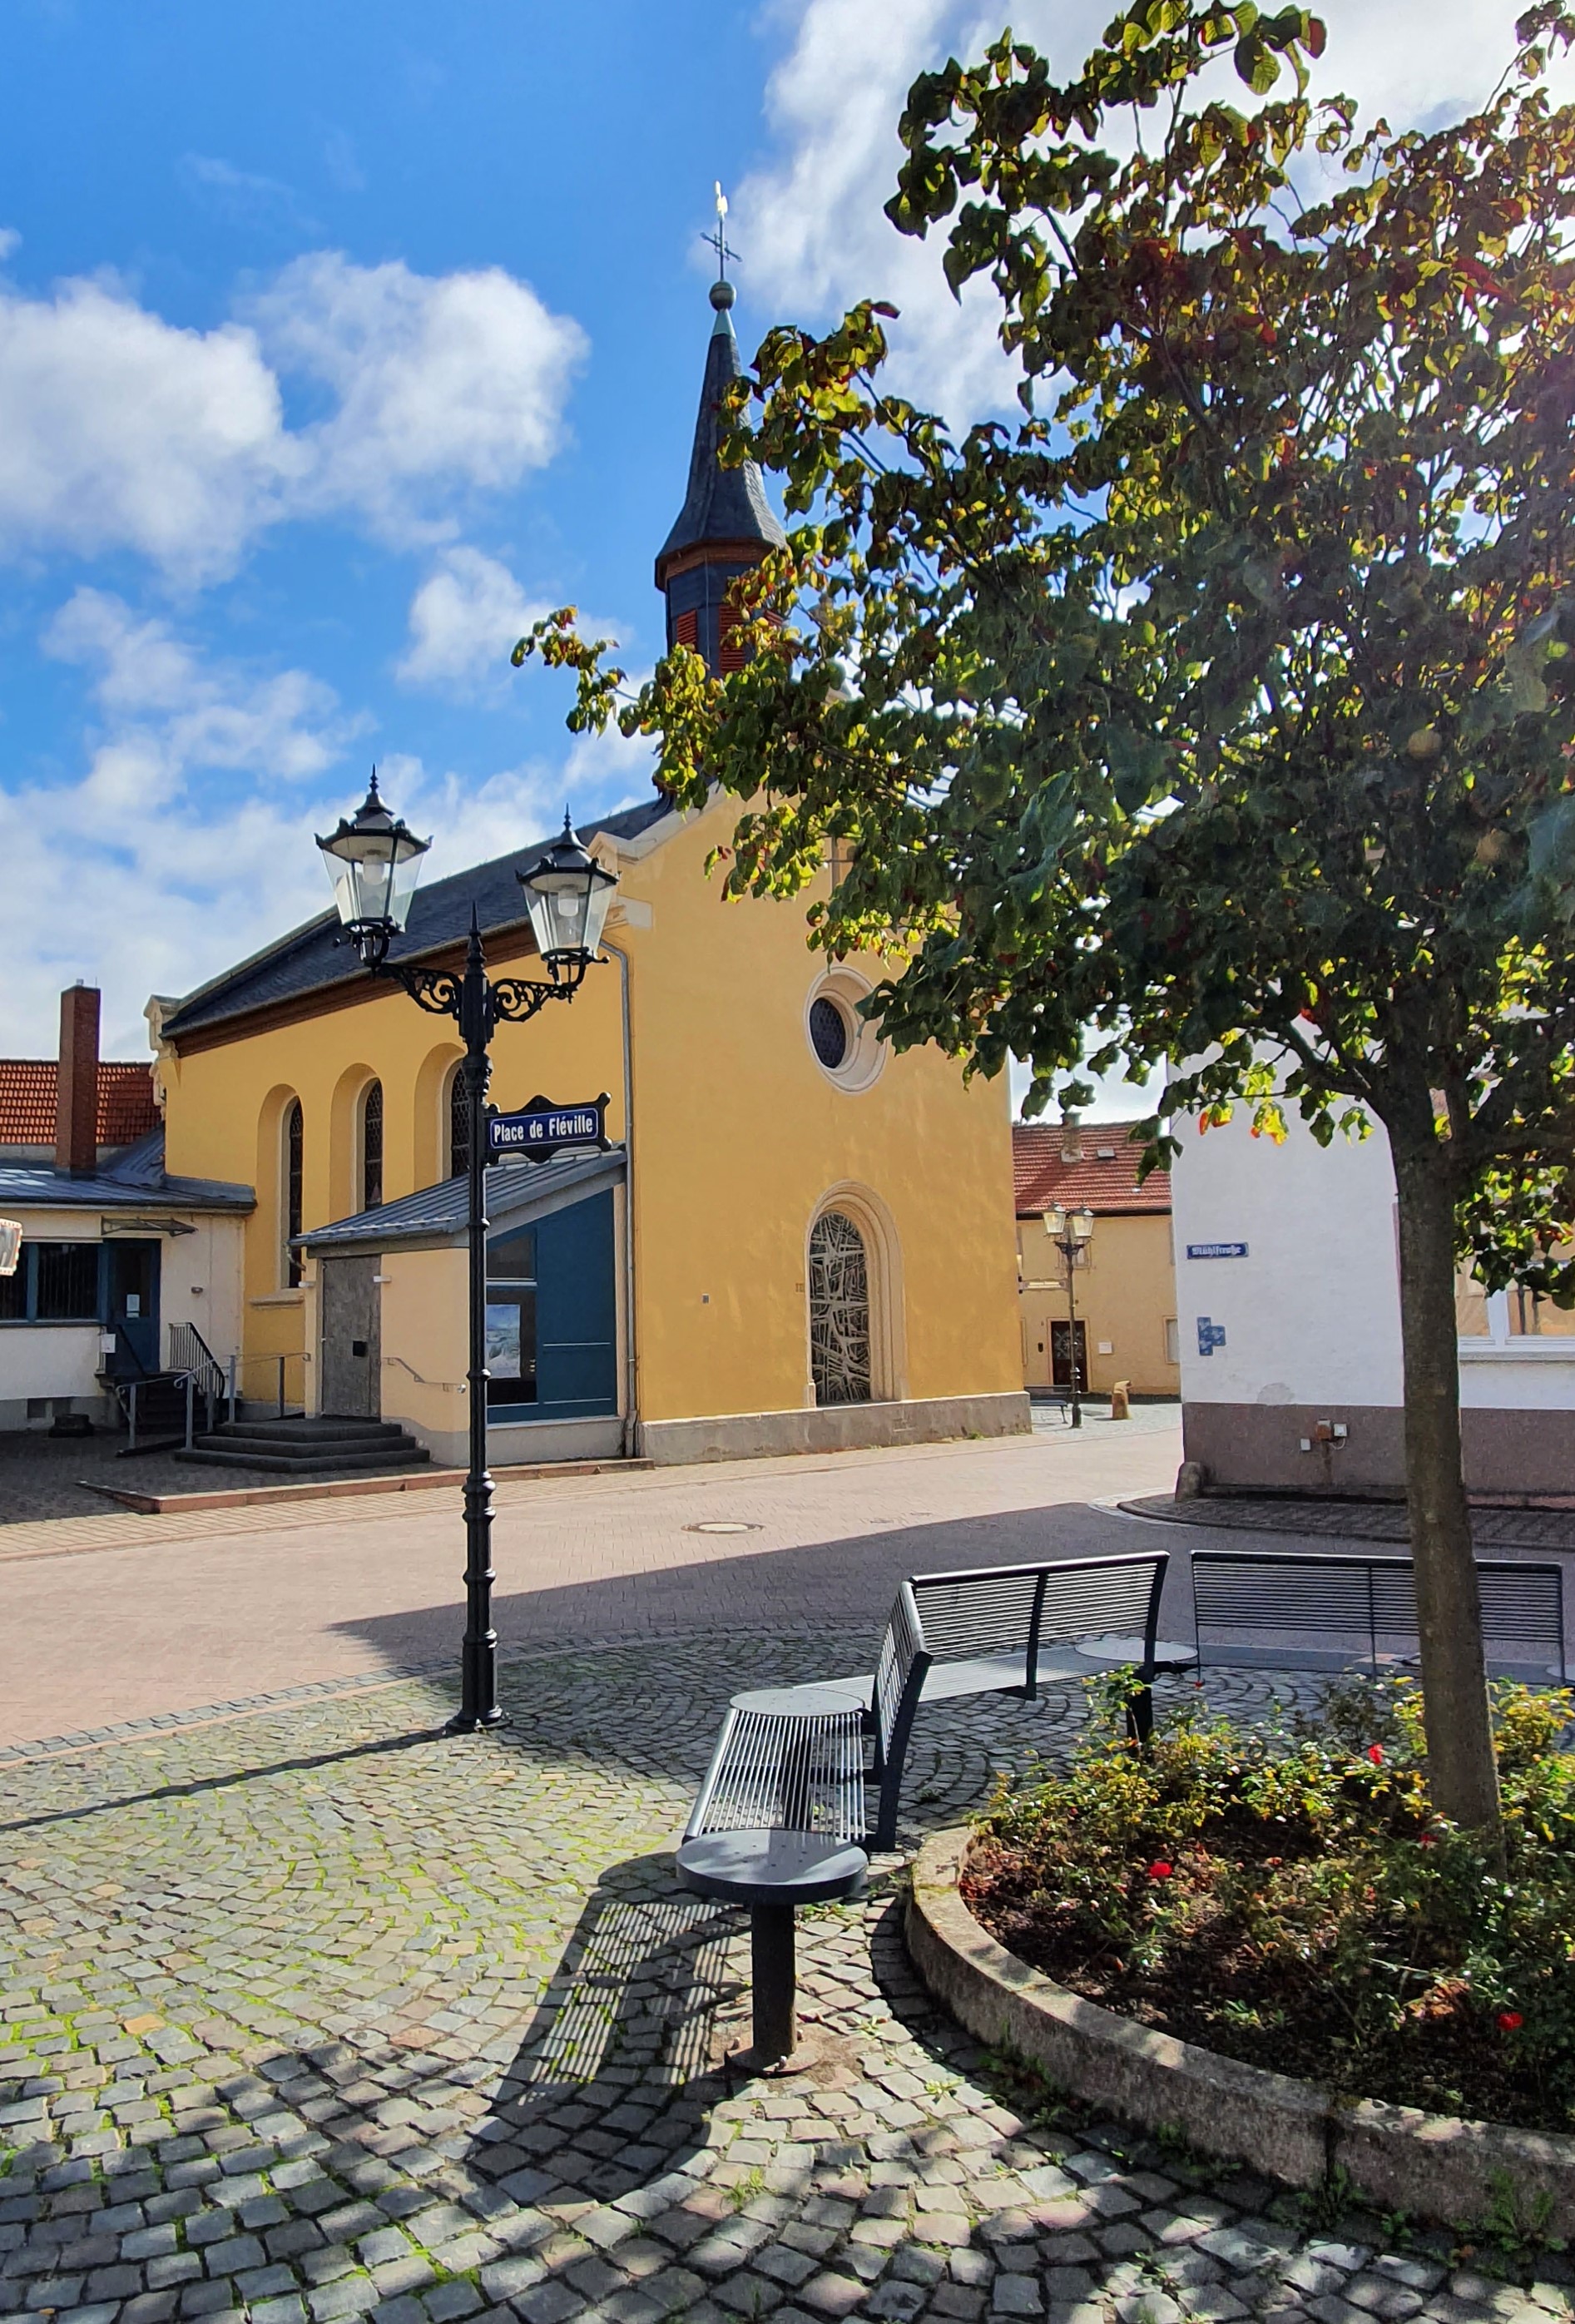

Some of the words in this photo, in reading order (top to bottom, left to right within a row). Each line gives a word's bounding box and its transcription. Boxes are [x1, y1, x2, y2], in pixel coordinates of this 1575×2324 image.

[493, 1124, 524, 1143] Place
[529, 1120, 543, 1139] de
[548, 1114, 593, 1137] Fléville
